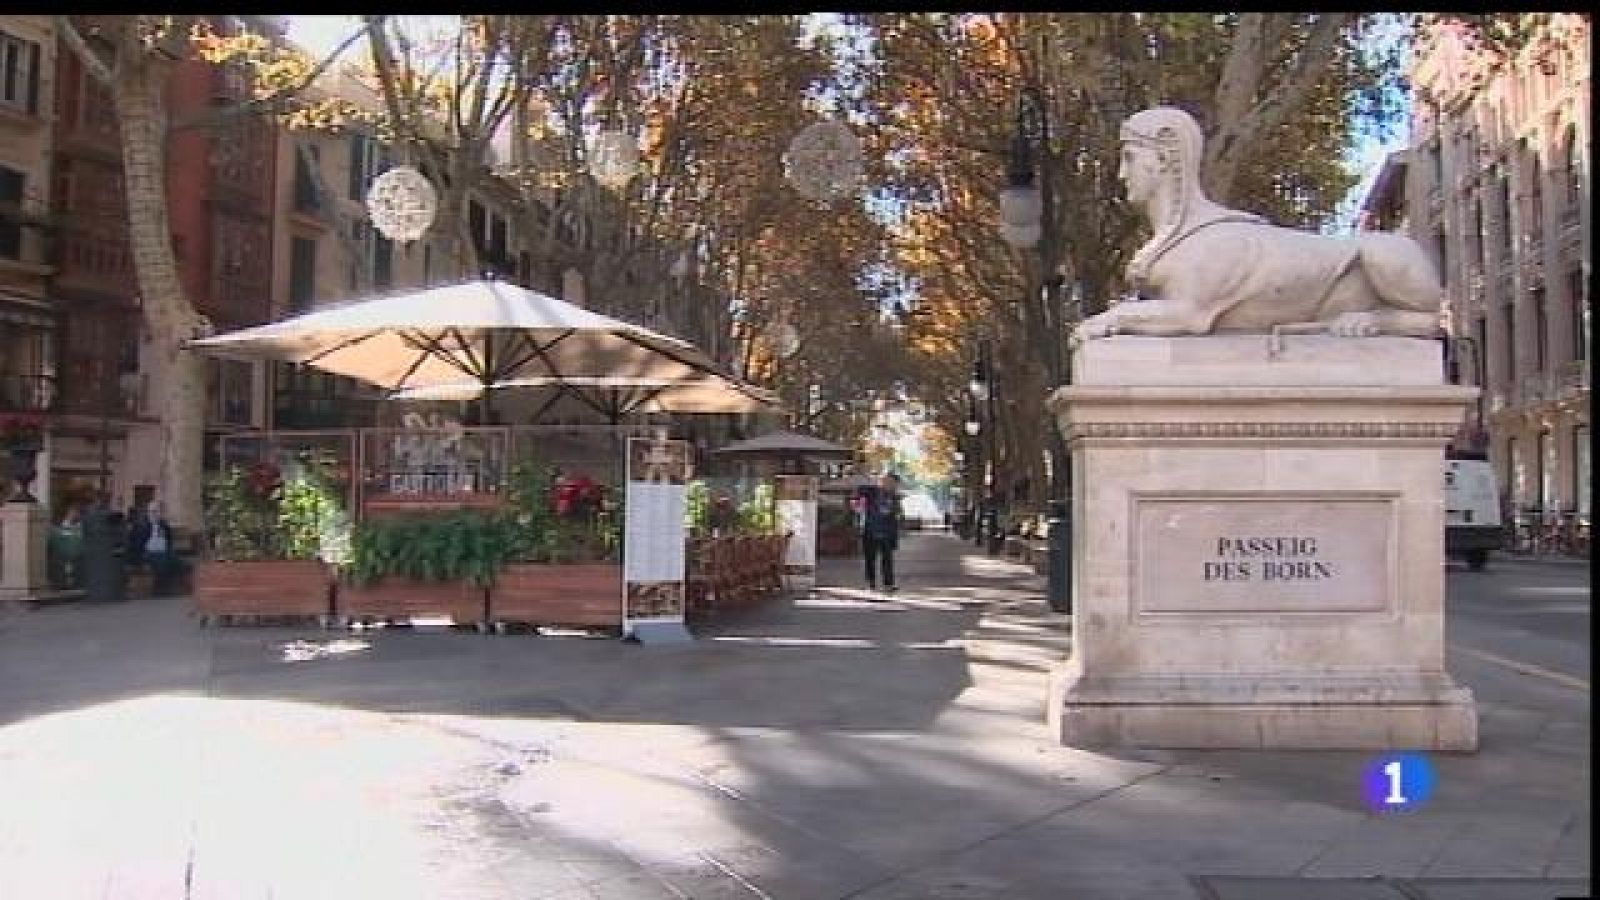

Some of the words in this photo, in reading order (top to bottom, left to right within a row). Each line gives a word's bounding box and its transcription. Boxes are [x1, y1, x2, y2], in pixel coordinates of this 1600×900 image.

[1217, 537, 1317, 557] PASSEIG
[1203, 562, 1251, 581] DES
[1262, 562, 1333, 581] BORN
